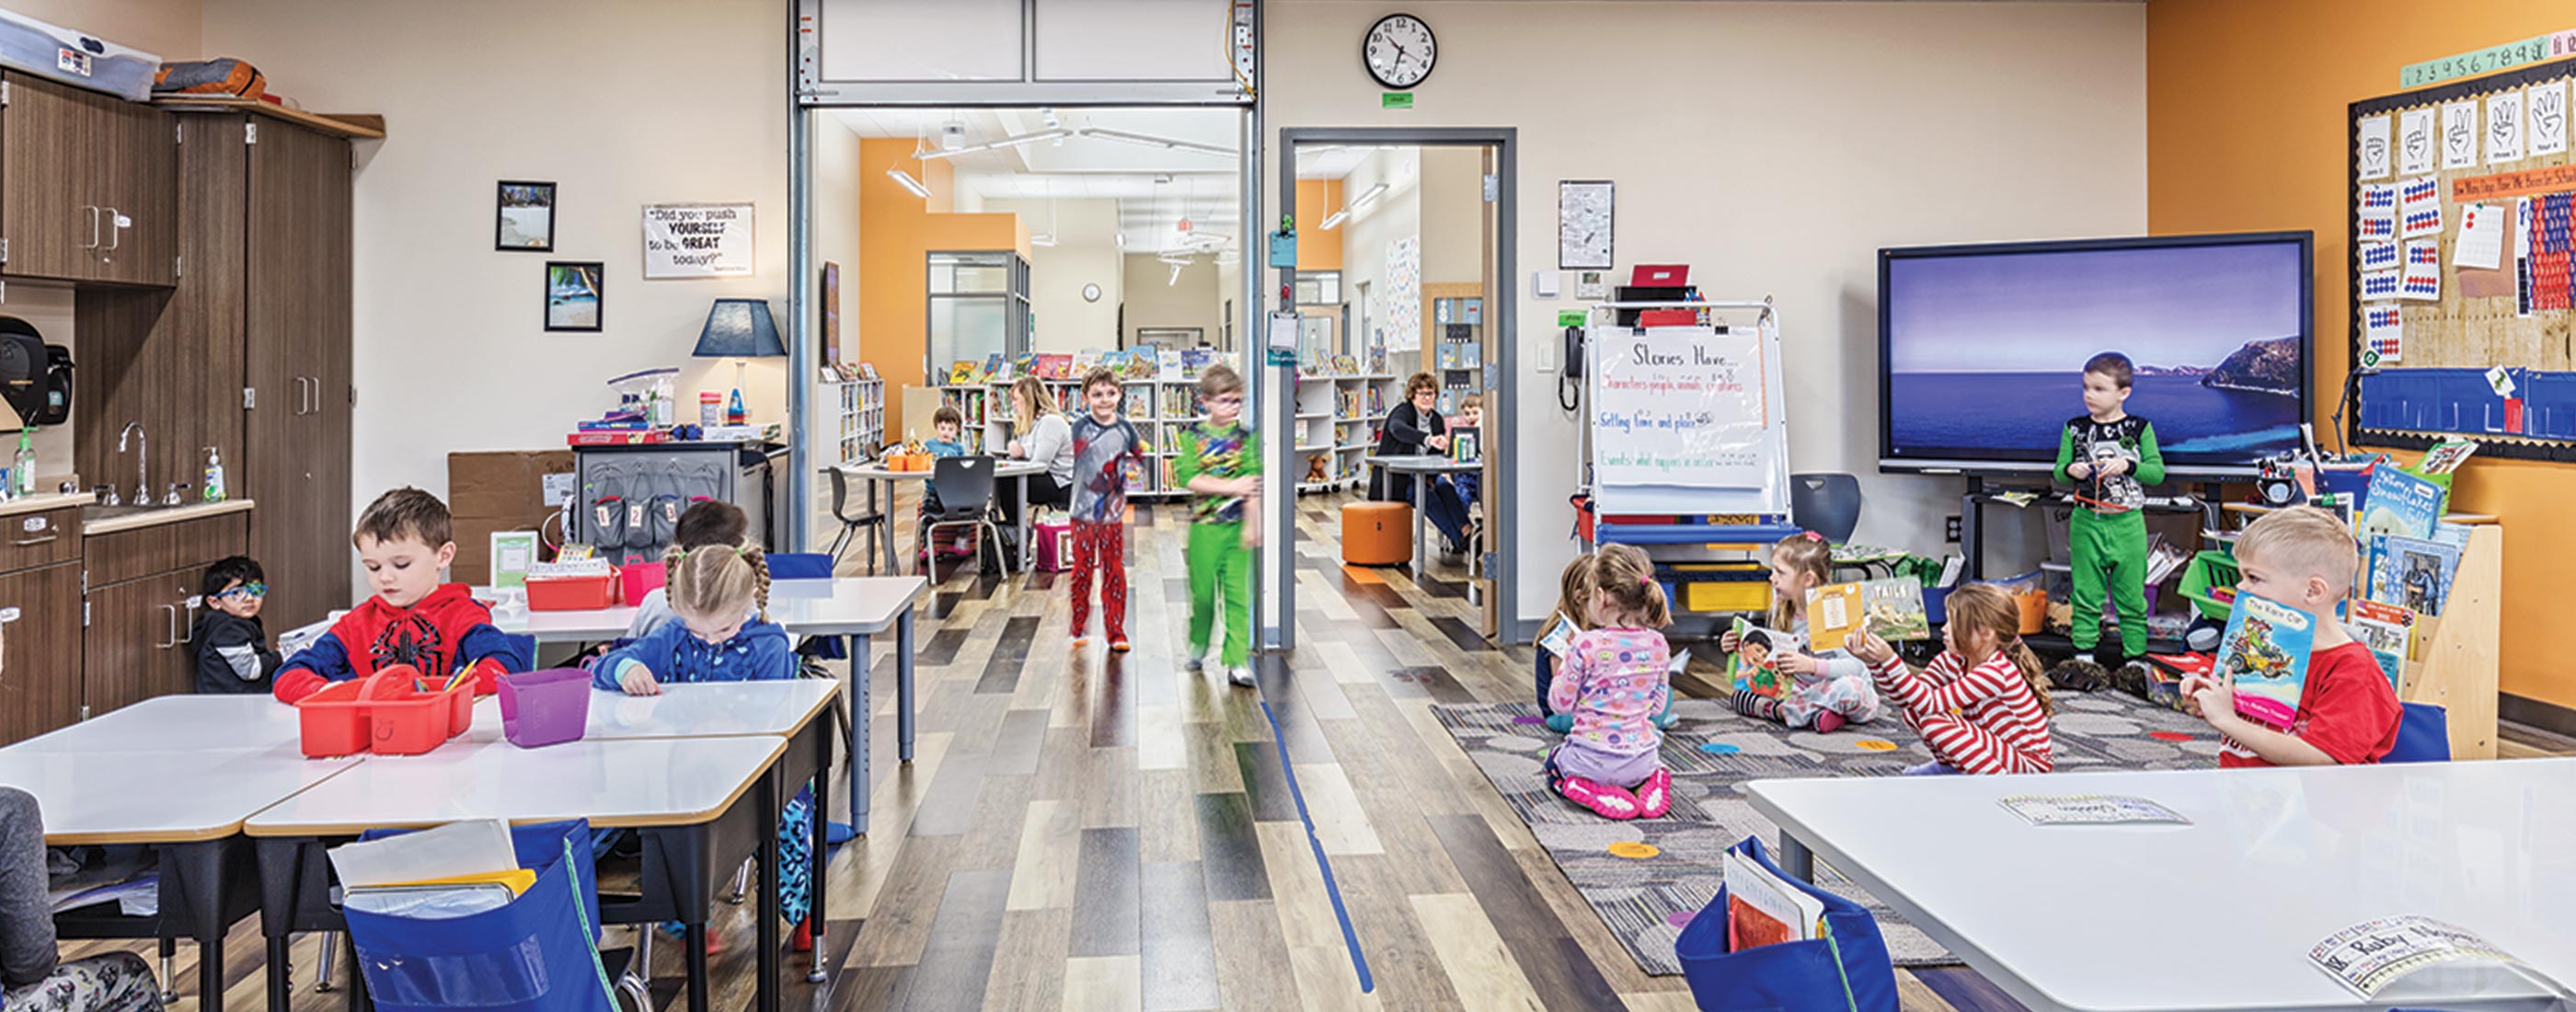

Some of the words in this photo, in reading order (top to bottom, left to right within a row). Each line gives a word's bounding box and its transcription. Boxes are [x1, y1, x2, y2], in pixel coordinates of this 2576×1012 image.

[1384, 22, 1392, 32] 11
[1396, 17, 1407, 29] 12
[1411, 22, 1416, 33] 1
[1372, 32, 1383, 42] 10
[1420, 32, 1428, 42] 2
[1369, 45, 1377, 56] 9
[1424, 45, 1432, 57] 3
[1420, 60, 1428, 70] 4
[2416, 69, 2422, 83] 2
[2429, 65, 2436, 80] 3
[2456, 58, 2467, 76] 5
[2470, 55, 2481, 74] 6
[2487, 53, 2497, 69] 7
[2500, 48, 2513, 66] 8
[2515, 45, 2527, 61] 9
[1384, 70, 1391, 80] 7
[1397, 74, 1405, 84] 6
[706, 207, 737, 221] push
[669, 222, 726, 236] YOURSELF
[649, 239, 662, 251] to
[682, 236, 720, 249] GREAT
[1633, 343, 1685, 367] Stories
[1658, 414, 1673, 428] and
[1674, 414, 1696, 434] place
[632, 509, 639, 523] 2
[668, 506, 675, 519] 3
[1874, 585, 1907, 599] TAILS
[2248, 598, 2262, 611] The
[2286, 612, 2303, 625] Car
[2350, 934, 2409, 957] Ruby
